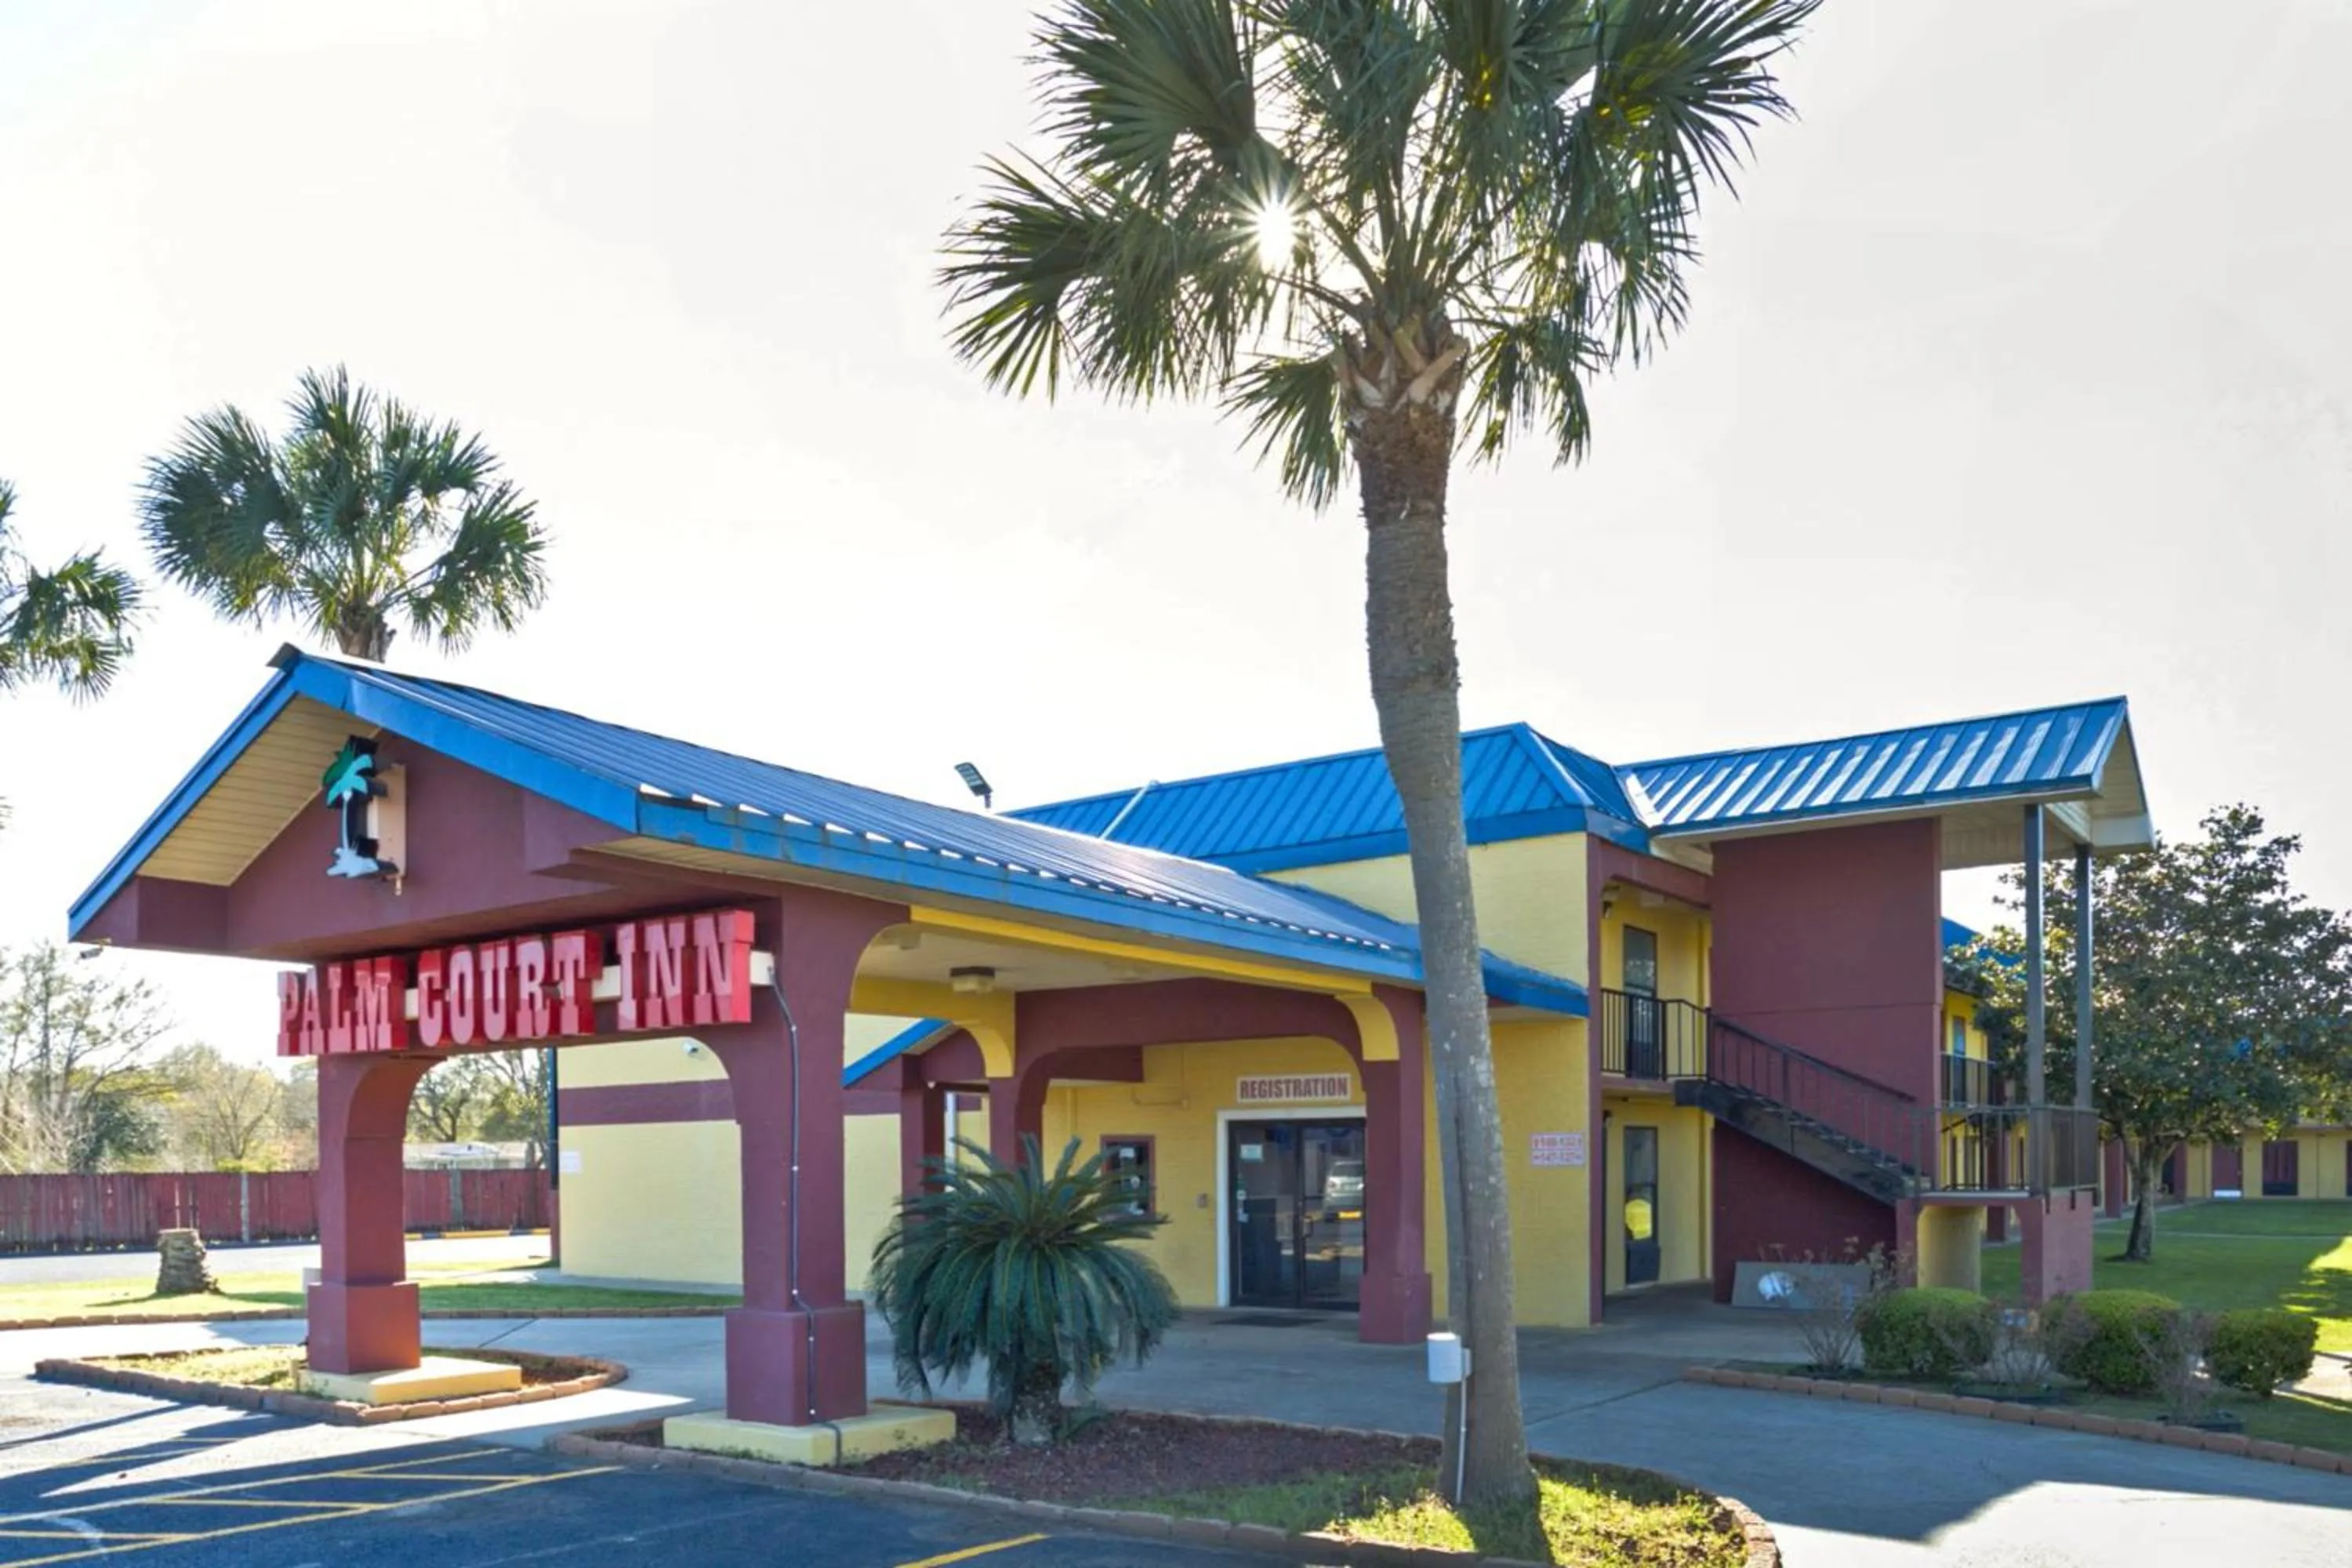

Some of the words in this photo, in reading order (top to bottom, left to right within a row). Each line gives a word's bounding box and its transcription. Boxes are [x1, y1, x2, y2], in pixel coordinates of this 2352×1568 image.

[277, 958, 394, 1056] PALM
[418, 931, 588, 1047] COURT
[617, 911, 739, 1030] INN
[1240, 1076, 1348, 1099] REGISTRATION
